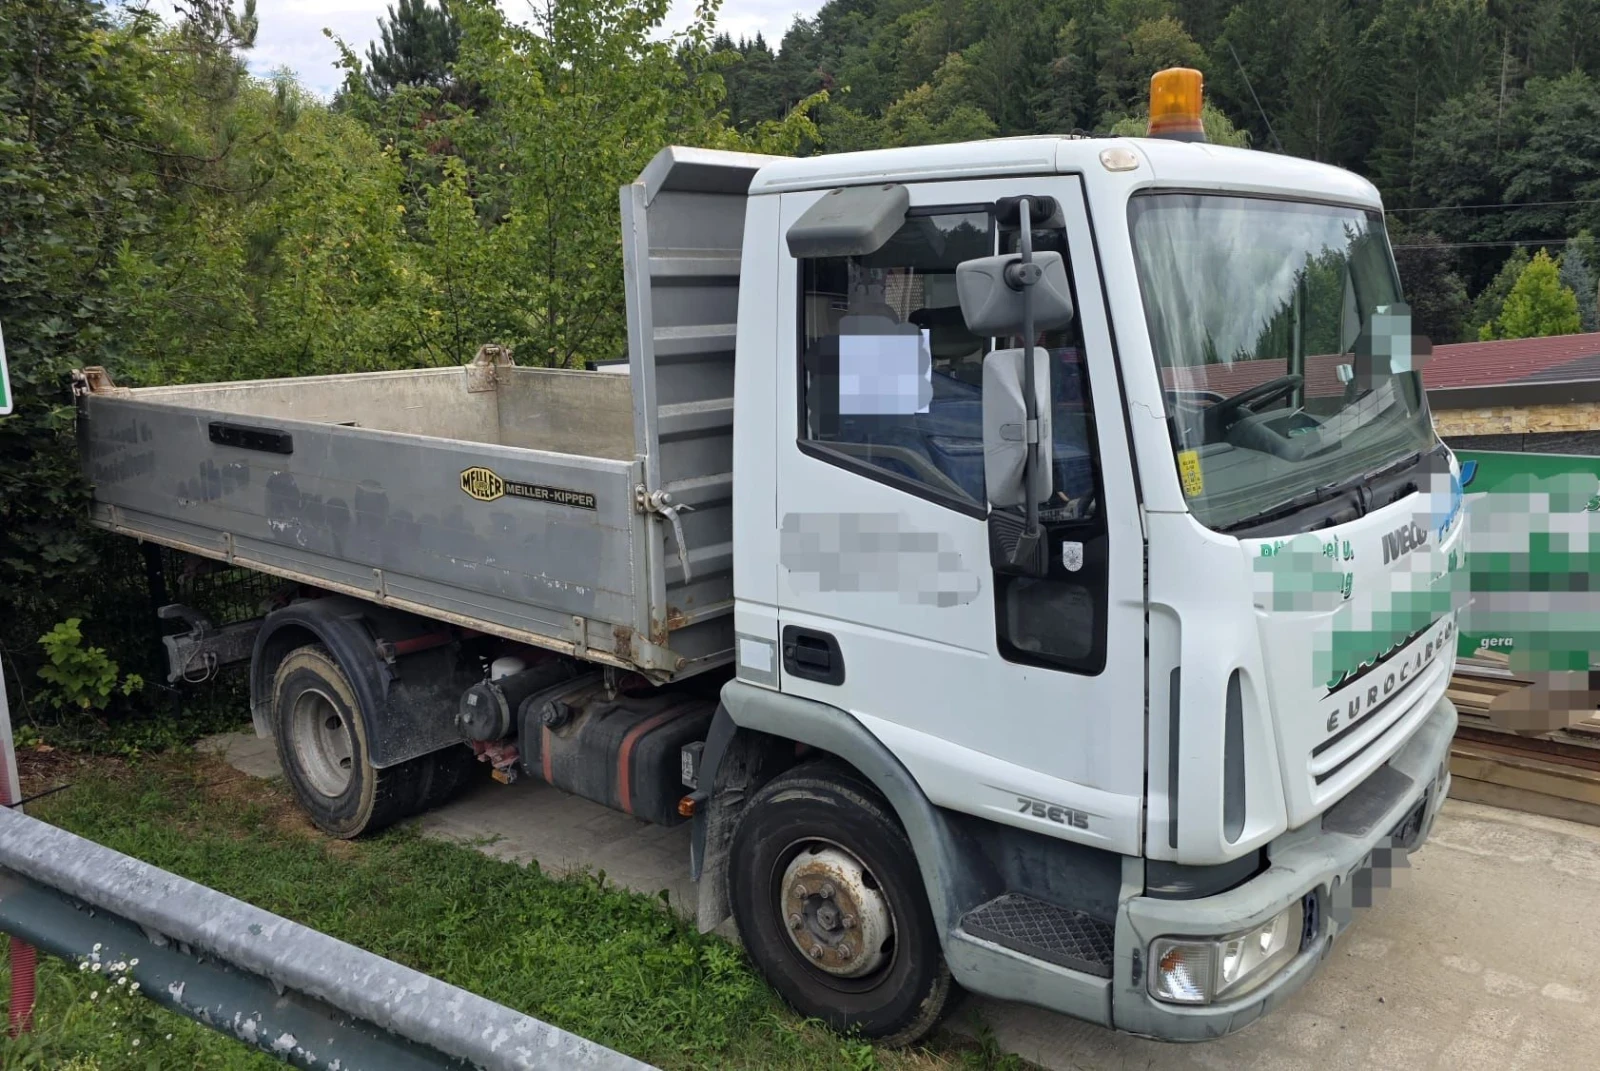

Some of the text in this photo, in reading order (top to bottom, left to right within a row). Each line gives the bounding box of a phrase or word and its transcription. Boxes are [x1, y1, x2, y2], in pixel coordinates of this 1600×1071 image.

[462, 470, 594, 506] MEILLER MEILLER-KIPPER
[1481, 636, 1514, 649] gera
[1326, 621, 1453, 732] EUROCARGO
[1017, 798, 1089, 829] 75E15
